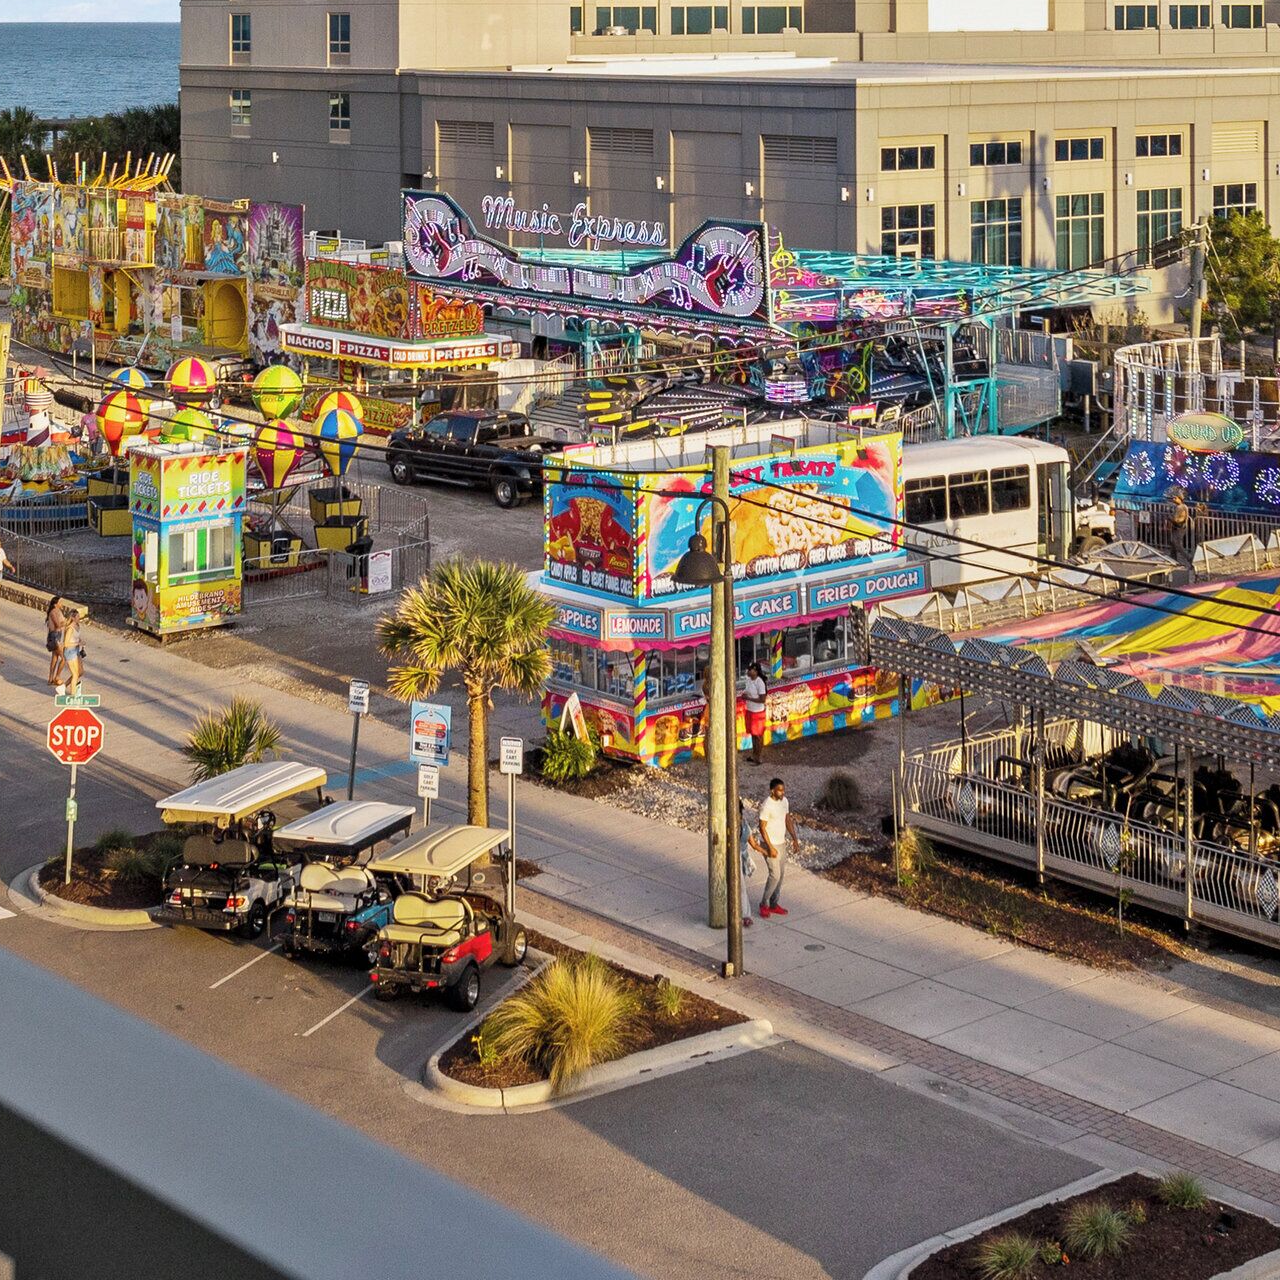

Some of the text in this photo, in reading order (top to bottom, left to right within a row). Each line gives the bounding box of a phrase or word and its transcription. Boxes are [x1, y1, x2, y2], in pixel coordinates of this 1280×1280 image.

[482, 195, 667, 251] Music Express
[312, 288, 349, 320] PIZZA
[423, 319, 479, 335] PRETZELS
[286, 333, 332, 351] NACHOS
[347, 343, 382, 359] PIZZA
[393, 350, 429, 363] COLD DRINKS
[436, 343, 496, 362] PRETZELS
[1172, 422, 1239, 444] ROUND UP
[138, 471, 153, 482] RIDE
[189, 471, 220, 484] RIDE
[133, 481, 158, 499] TICKETS
[178, 480, 232, 498] TICKETS
[755, 552, 801, 576] COTTON CANDY
[809, 548, 827, 565] FRIED
[816, 570, 919, 605] FRIED DOUGH
[189, 604, 212, 614] RIDES
[680, 595, 794, 632] FUNL CAKE
[558, 608, 598, 631] APPLES
[611, 617, 662, 634] LEMONADE
[51, 724, 100, 747] STOP
